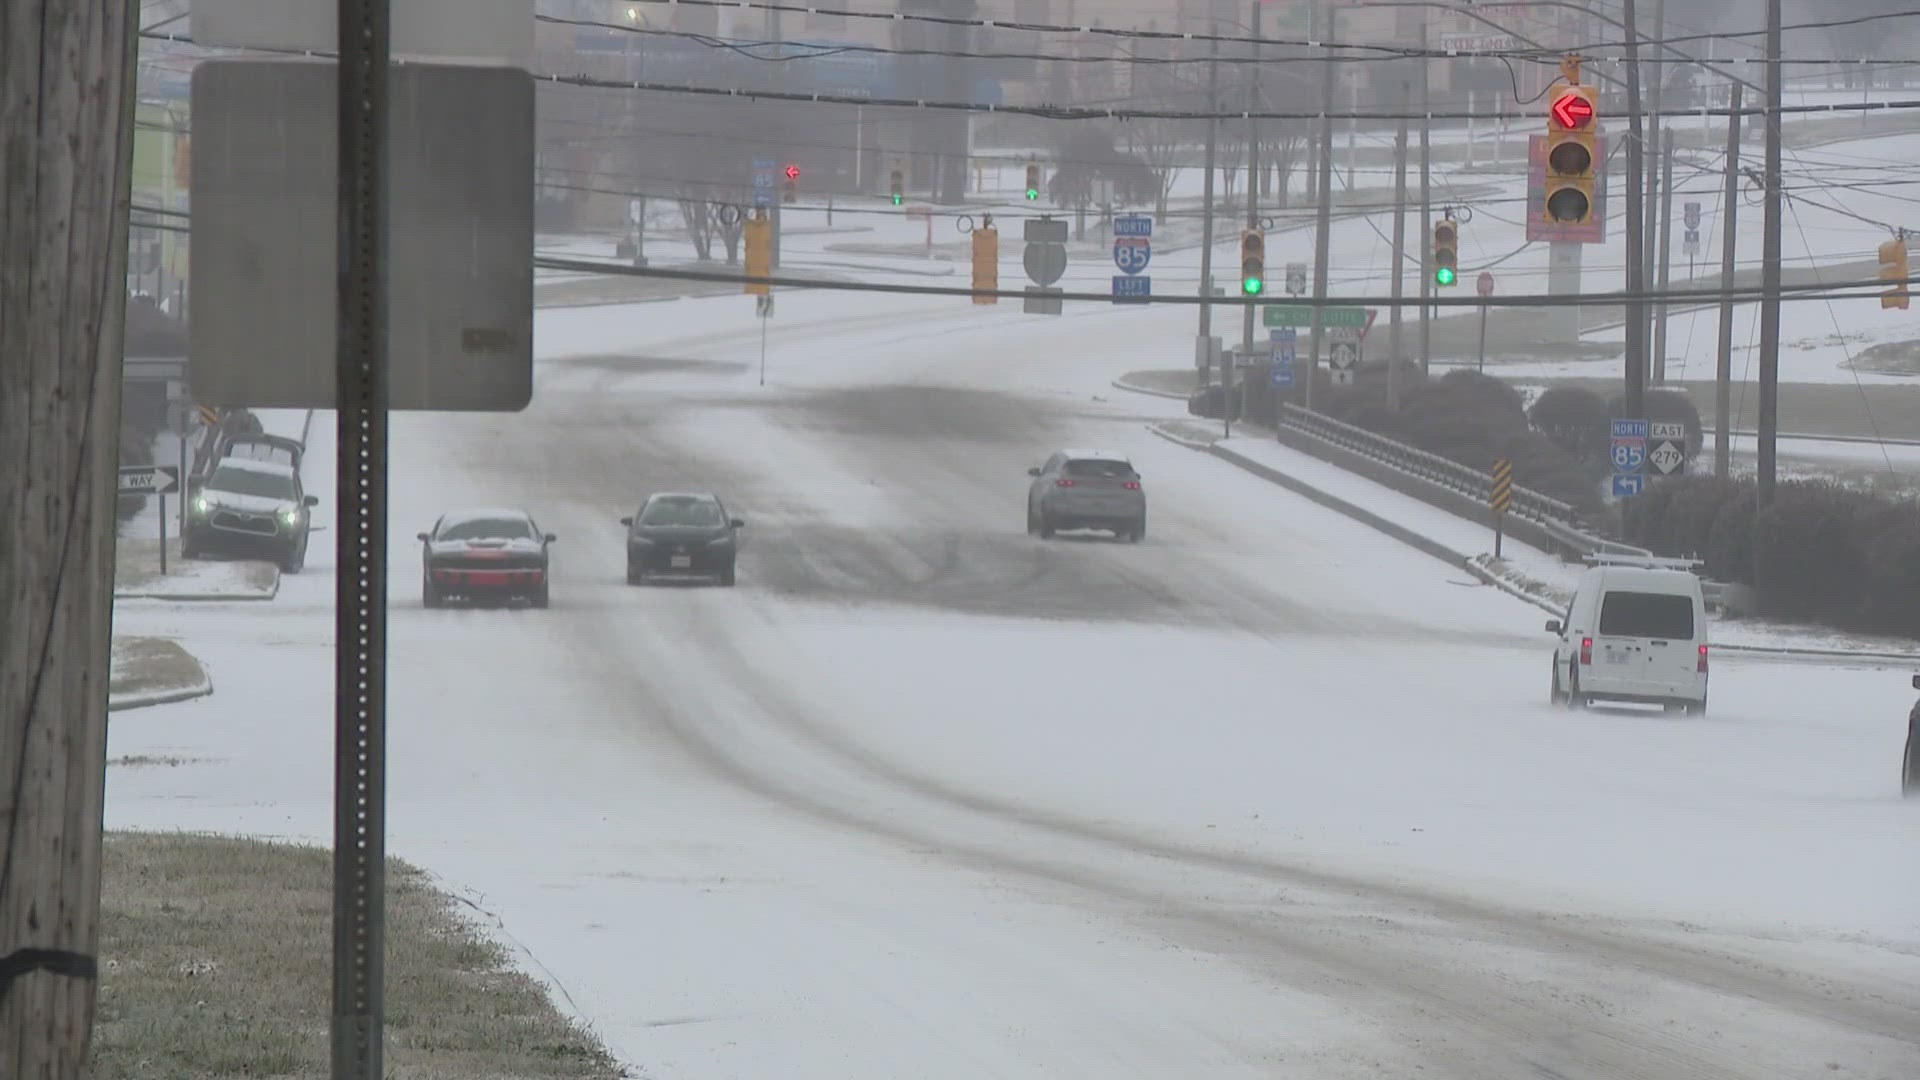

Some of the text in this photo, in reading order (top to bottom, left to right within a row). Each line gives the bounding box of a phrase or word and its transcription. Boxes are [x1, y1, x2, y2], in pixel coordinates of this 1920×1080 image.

[1116, 221, 1150, 233] NORTH
[1117, 246, 1147, 267] 85
[1613, 423, 1646, 435] NORTH
[1653, 426, 1682, 437] EAST
[1614, 446, 1642, 465] 85
[1655, 451, 1679, 464] 279
[129, 474, 153, 487] WAY
